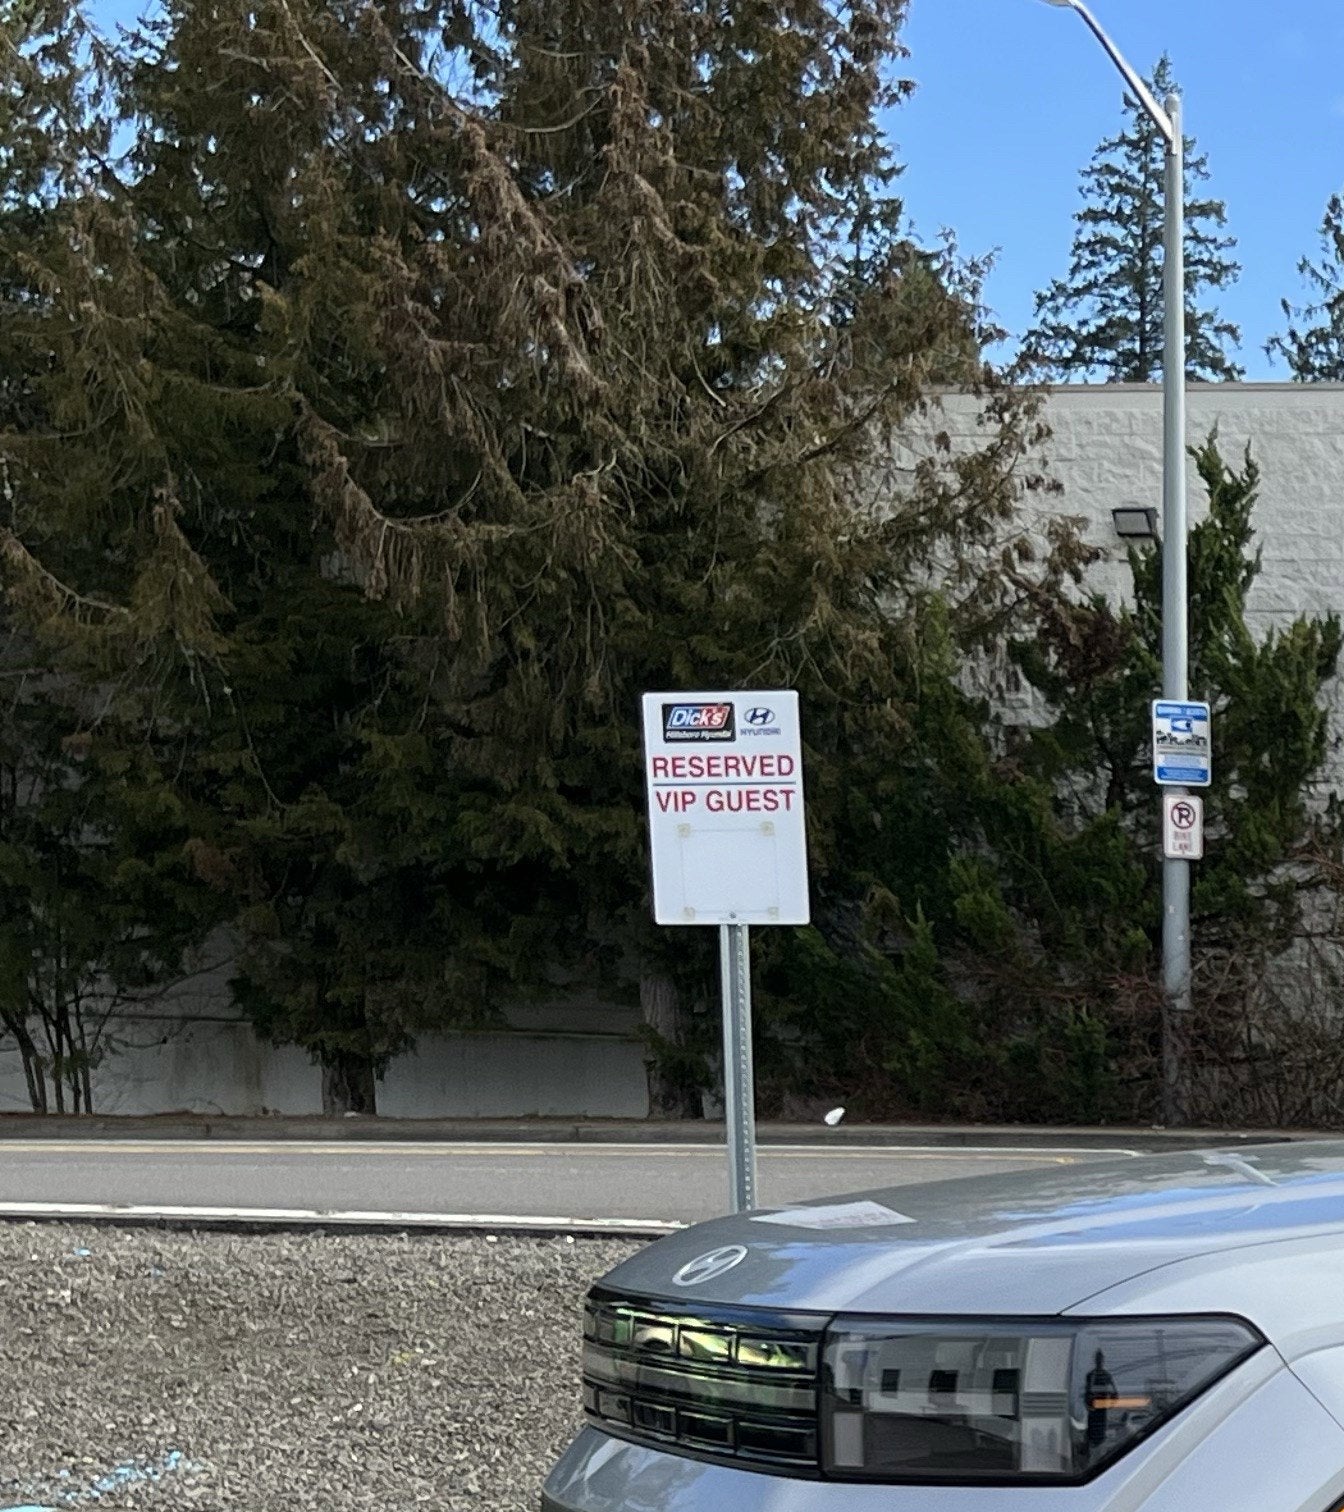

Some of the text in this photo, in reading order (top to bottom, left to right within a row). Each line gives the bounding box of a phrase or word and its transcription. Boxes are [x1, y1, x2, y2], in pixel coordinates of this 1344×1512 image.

[670, 706, 724, 728] Dick's
[652, 755, 795, 779] RESERVED
[656, 789, 796, 812] VIP GUEST
